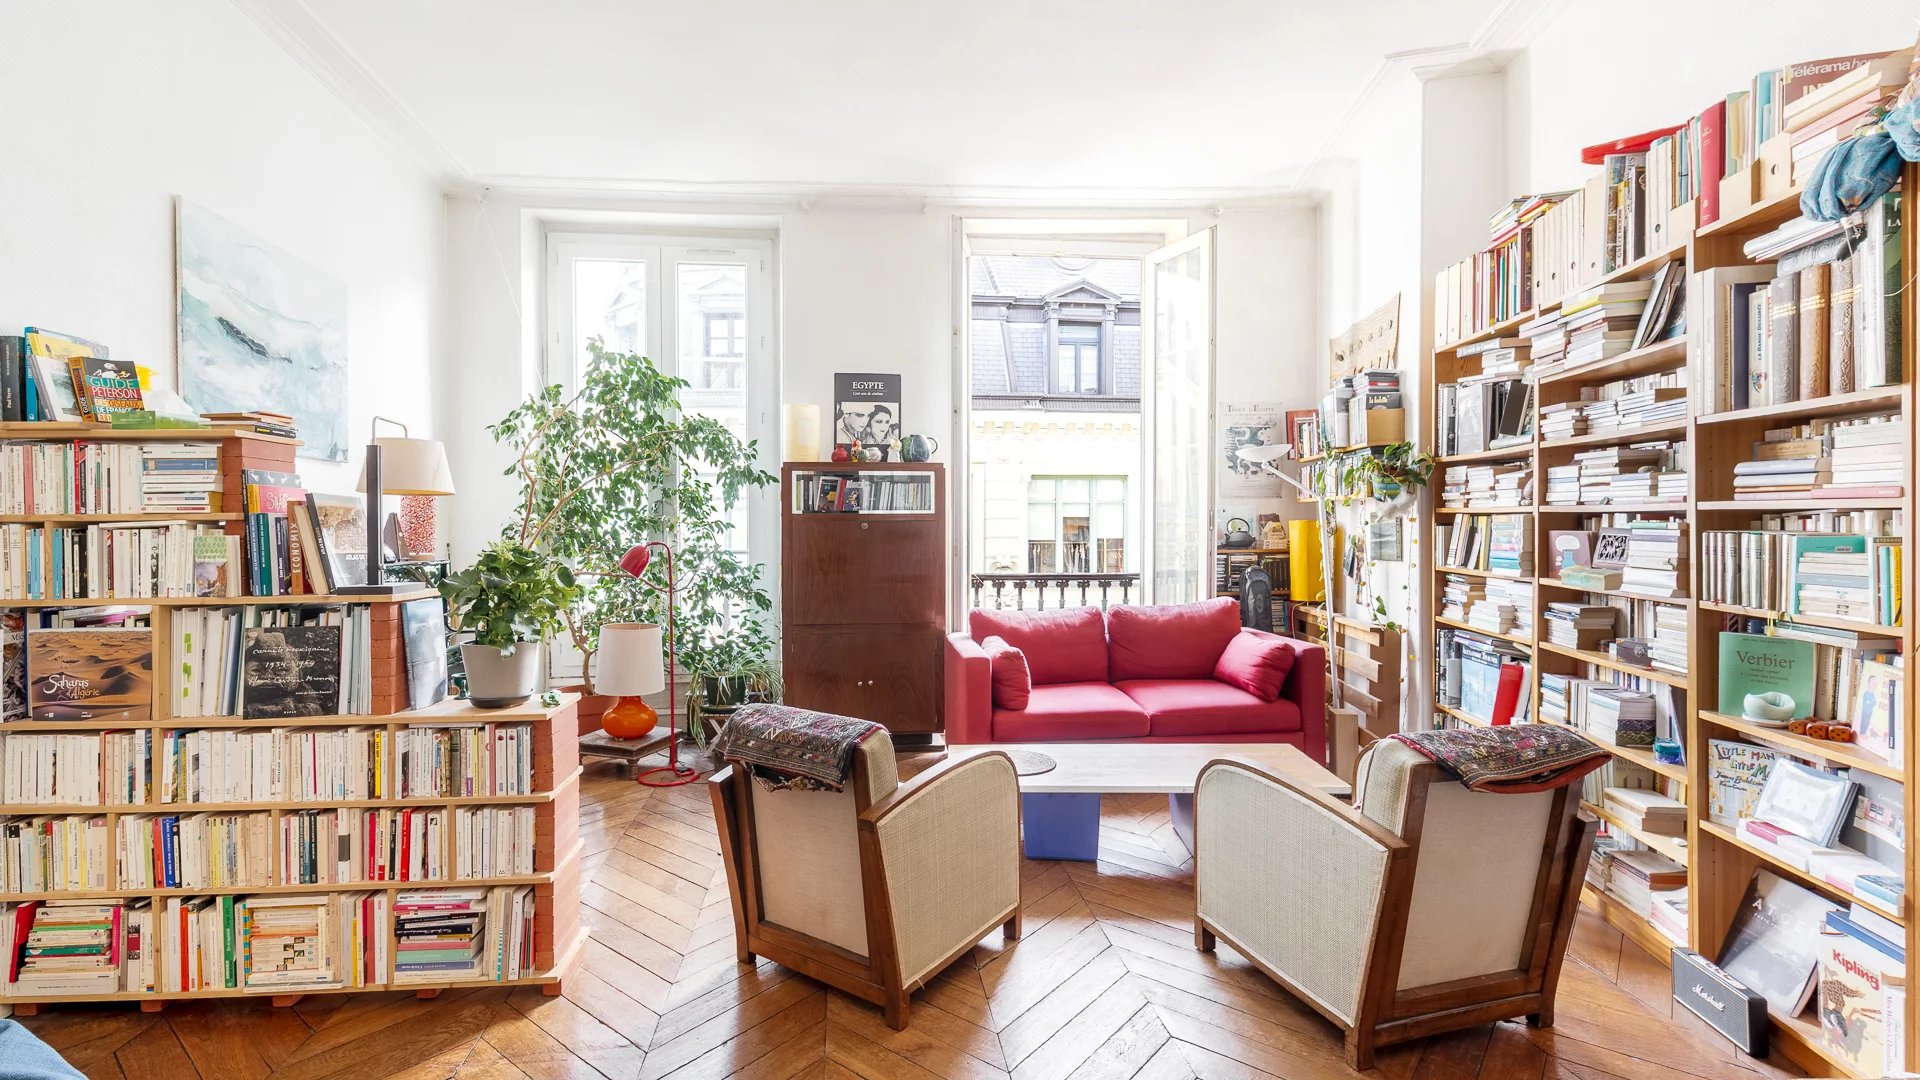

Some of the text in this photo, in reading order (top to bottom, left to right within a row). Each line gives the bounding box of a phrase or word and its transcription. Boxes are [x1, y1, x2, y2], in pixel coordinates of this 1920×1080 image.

[1790, 60, 1850, 78] Télérama
[90, 376, 134, 389] GUIDE
[852, 382, 884, 390] EGYPTE
[92, 386, 138, 398] PETERSON
[79, 396, 90, 414] GUIDE
[108, 400, 140, 408] OISEAUX
[290, 522, 300, 573] ECONOMIX
[1736, 650, 1795, 669] Verbier
[43, 675, 89, 694] Saharas
[66, 686, 100, 699] d'Algérie
[1714, 744, 1776, 761] LITTLE MAN
[1832, 948, 1880, 991] Kipling
[1692, 984, 1726, 1012] Marshall
